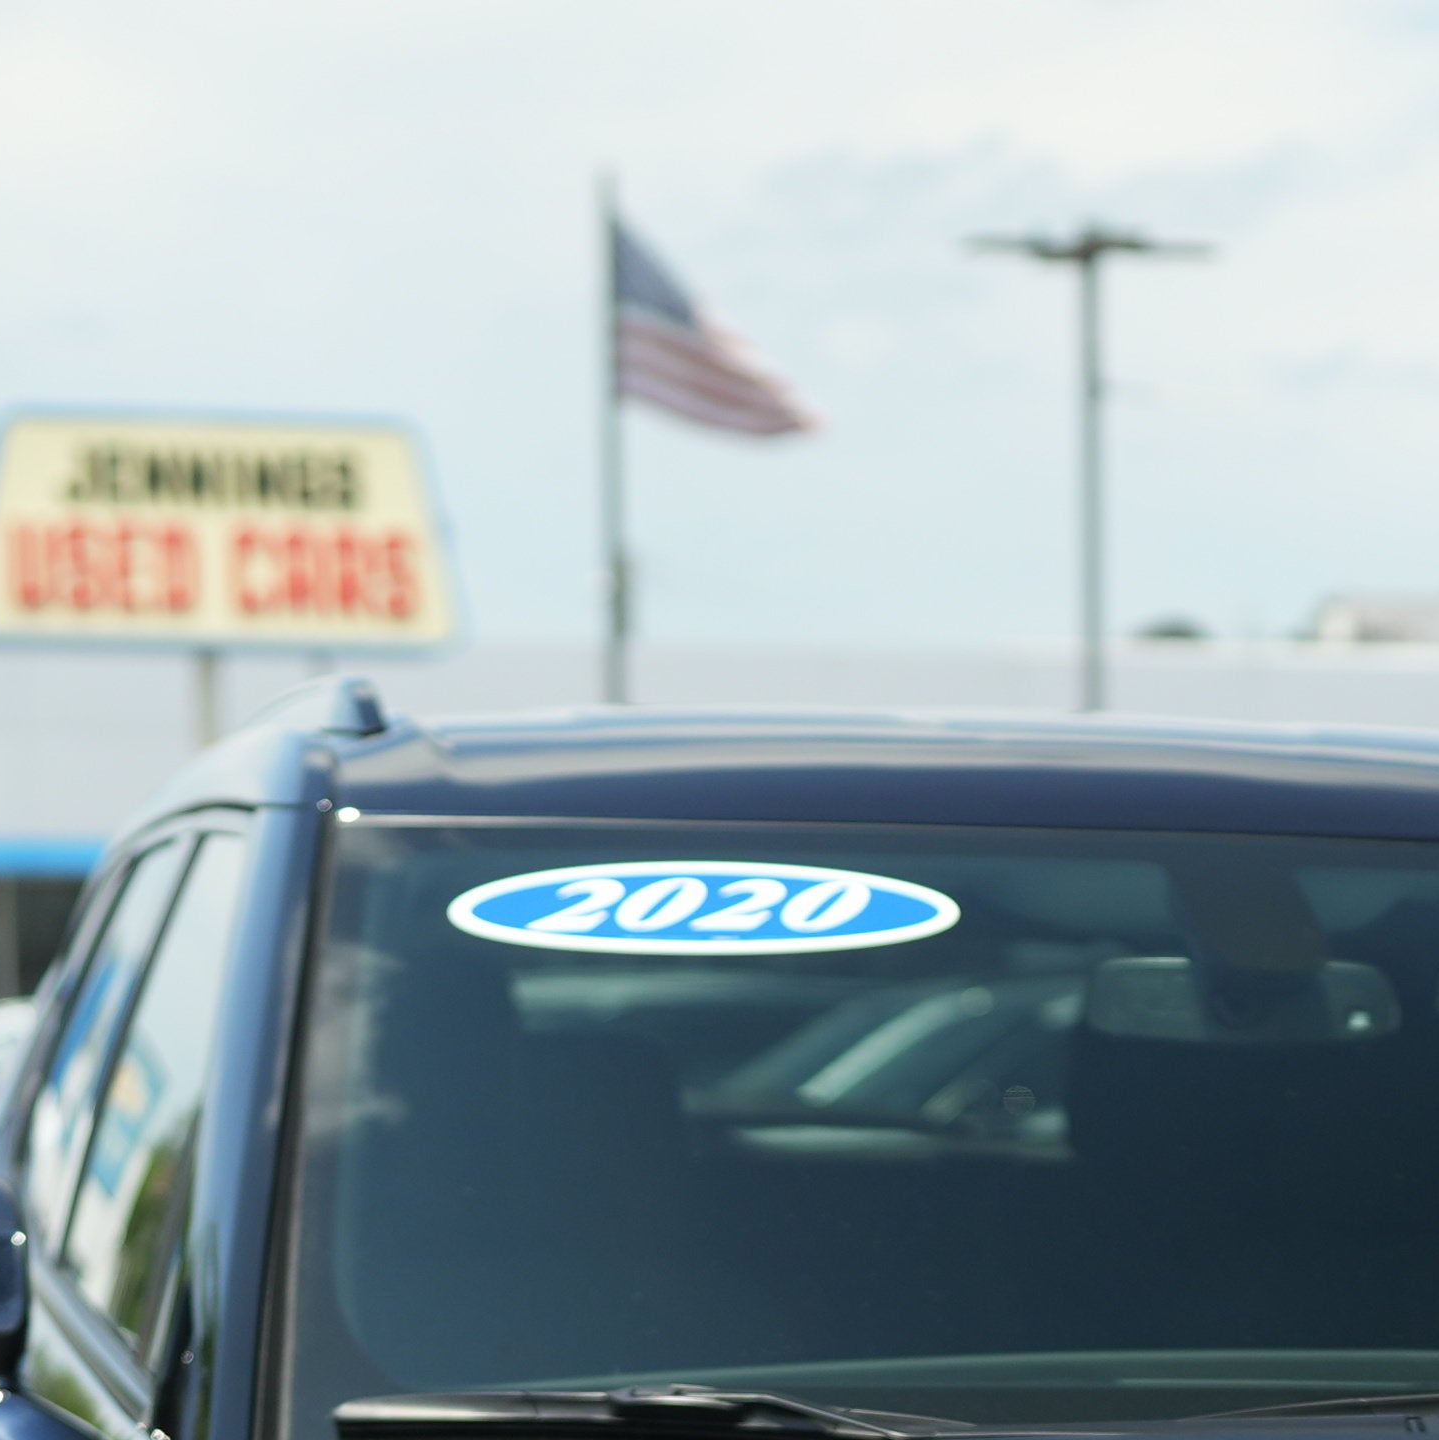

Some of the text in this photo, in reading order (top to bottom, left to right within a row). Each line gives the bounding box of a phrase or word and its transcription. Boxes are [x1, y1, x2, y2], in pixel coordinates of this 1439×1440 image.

[11, 525, 419, 622] USED CARS
[526, 876, 872, 934] 2020
